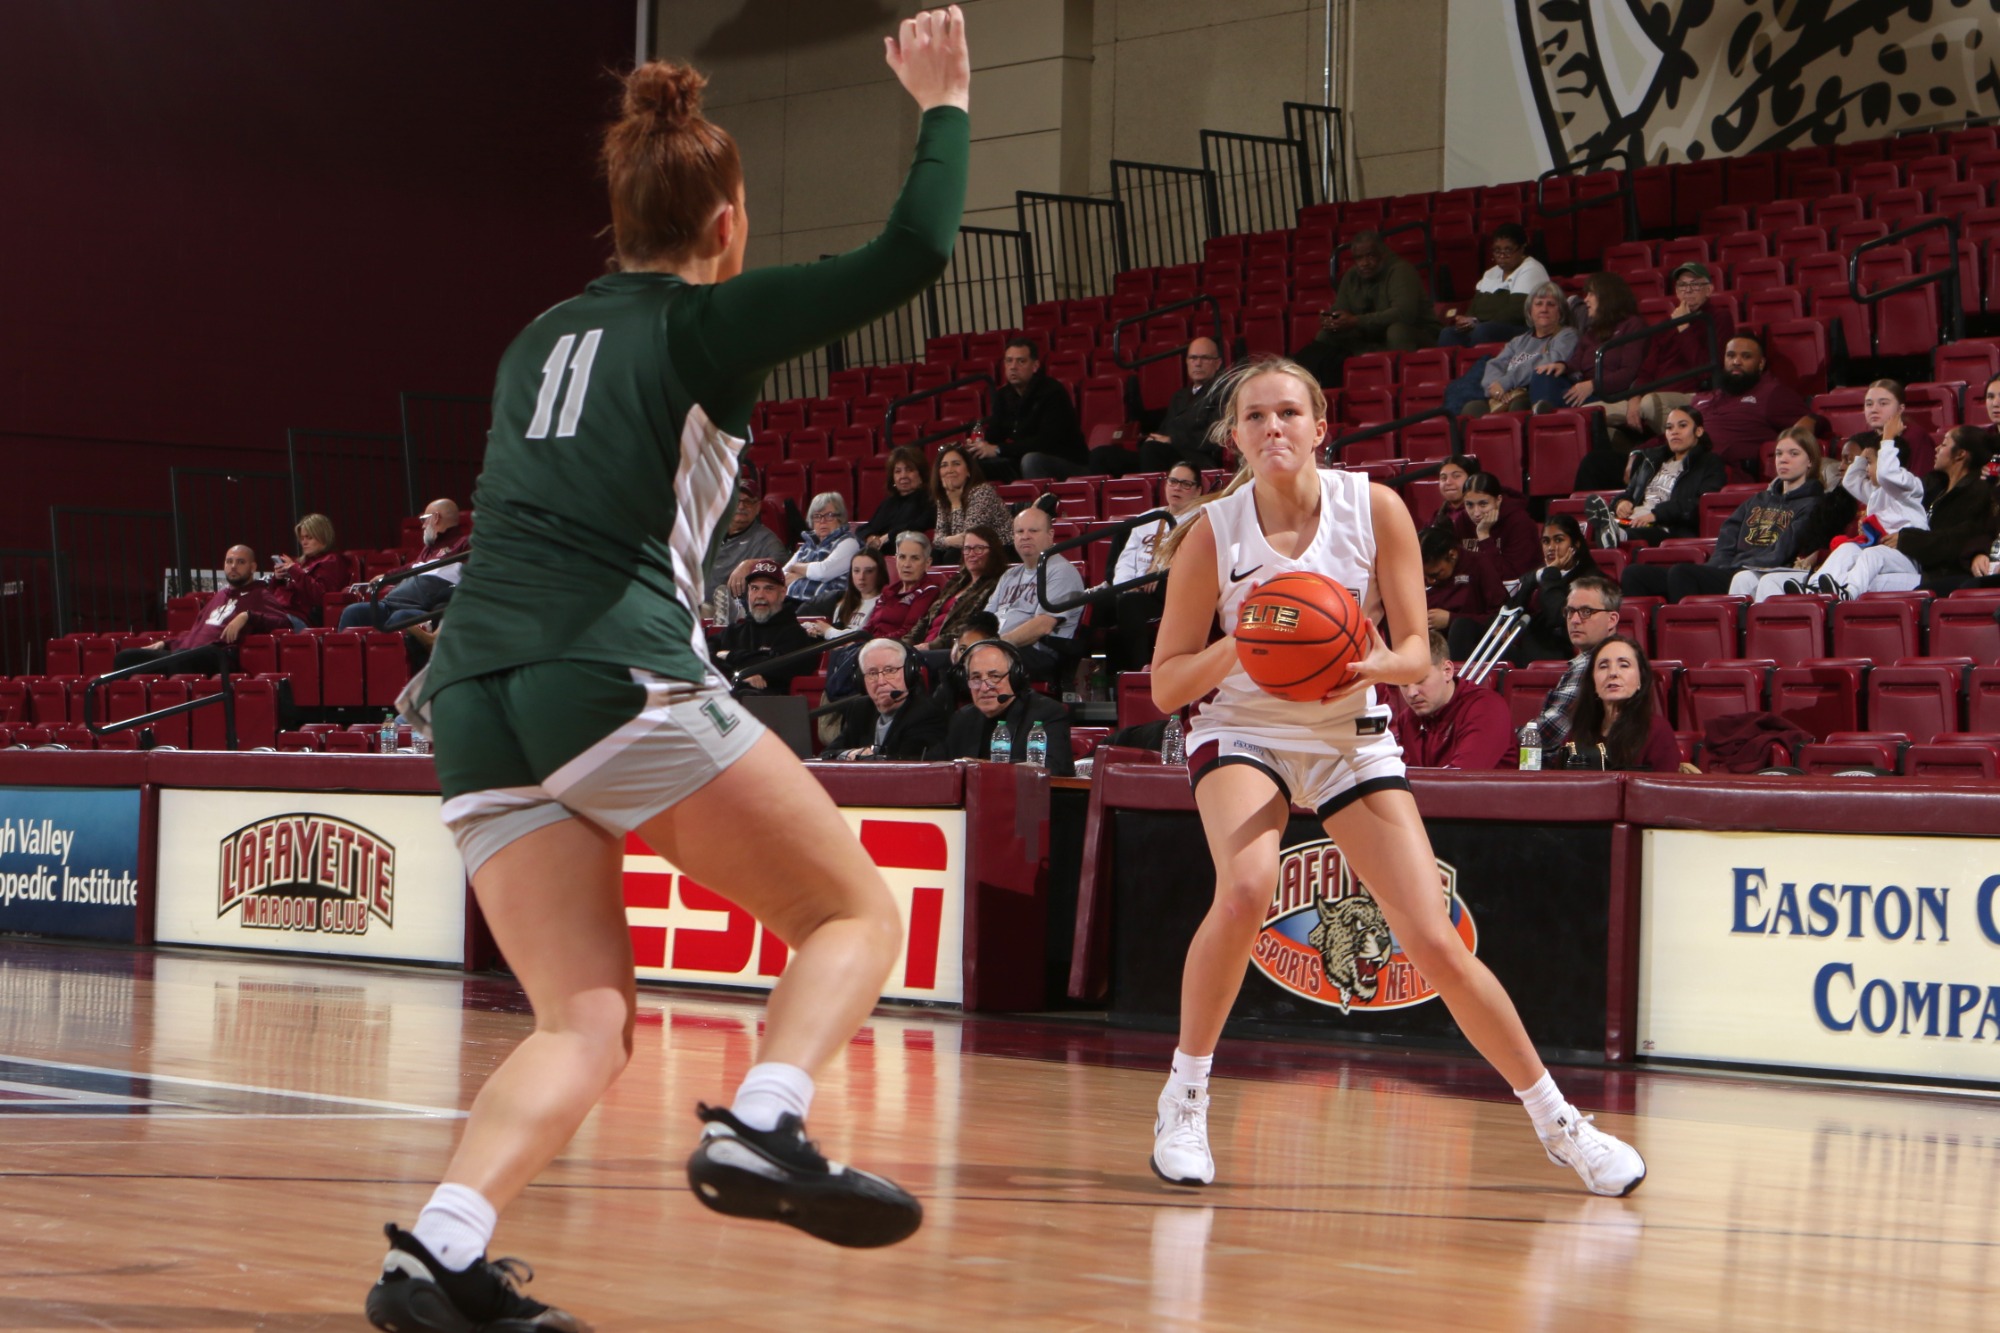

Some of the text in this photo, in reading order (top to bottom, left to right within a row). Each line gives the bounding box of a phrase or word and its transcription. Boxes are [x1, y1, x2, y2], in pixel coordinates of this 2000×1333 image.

[525, 328, 603, 439] 11
[1241, 604, 1300, 628] ELITE
[699, 697, 741, 738] L
[19, 818, 74, 866] Valley
[62, 866, 138, 906] Institute
[218, 816, 396, 928] LAFAYETTE
[241, 895, 369, 936] MAROON CLUB
[1730, 867, 1950, 942] EASTON
[1255, 932, 1322, 994] SPORTS
